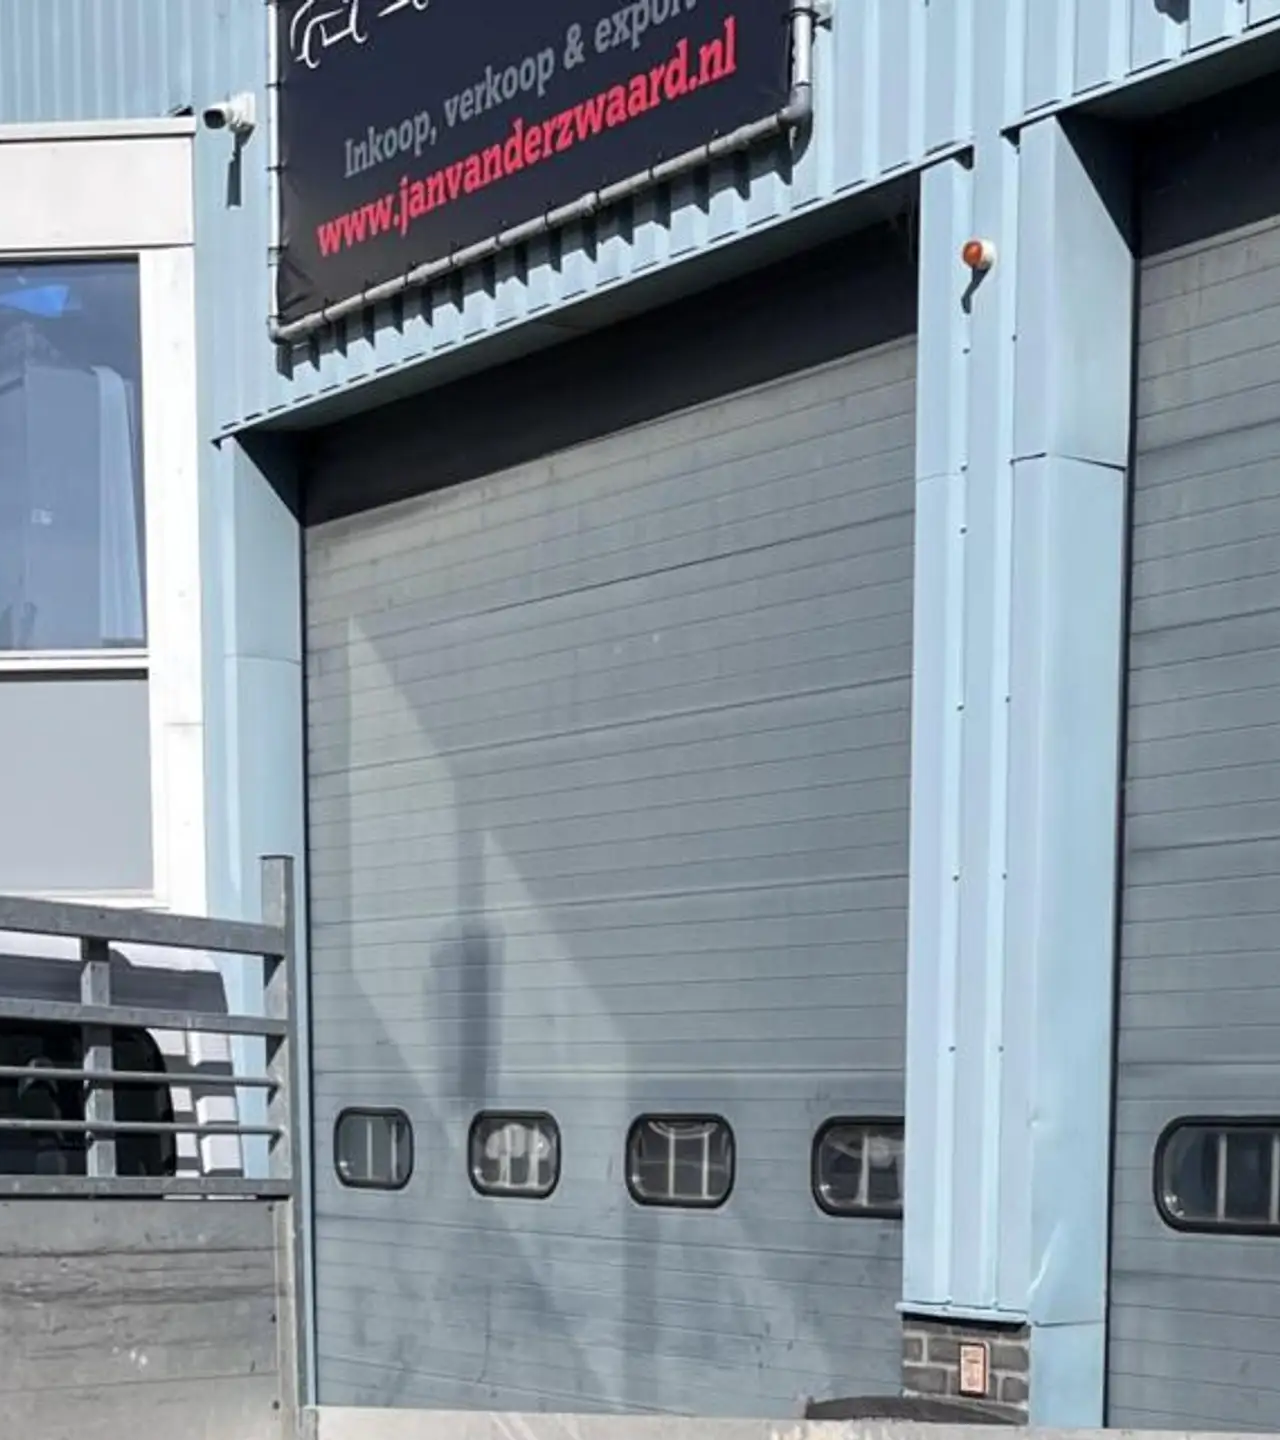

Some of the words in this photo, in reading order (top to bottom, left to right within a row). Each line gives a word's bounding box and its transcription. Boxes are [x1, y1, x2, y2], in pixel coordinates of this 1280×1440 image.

[316, 14, 737, 257] www.janvanderzwaard.nl
[344, 110, 438, 179] Inkoop,
[444, 48, 555, 127] verkoop
[563, 22, 586, 70] &
